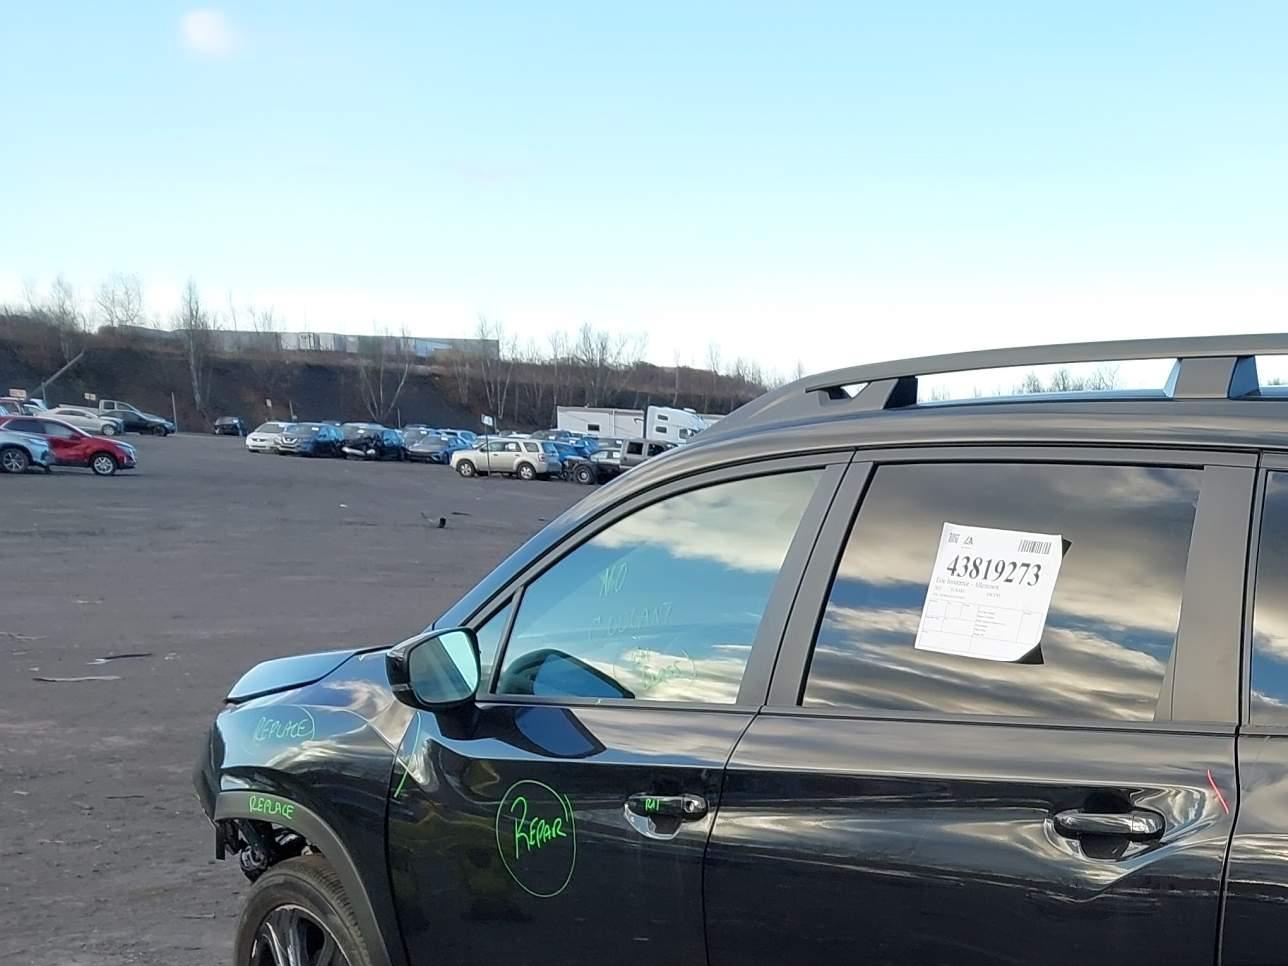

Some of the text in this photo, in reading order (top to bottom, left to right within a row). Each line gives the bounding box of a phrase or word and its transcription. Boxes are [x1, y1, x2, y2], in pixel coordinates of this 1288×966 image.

[946, 554, 1042, 587] 43819273
[254, 716, 313, 742] REPLACE
[249, 795, 296, 820] REPLACE
